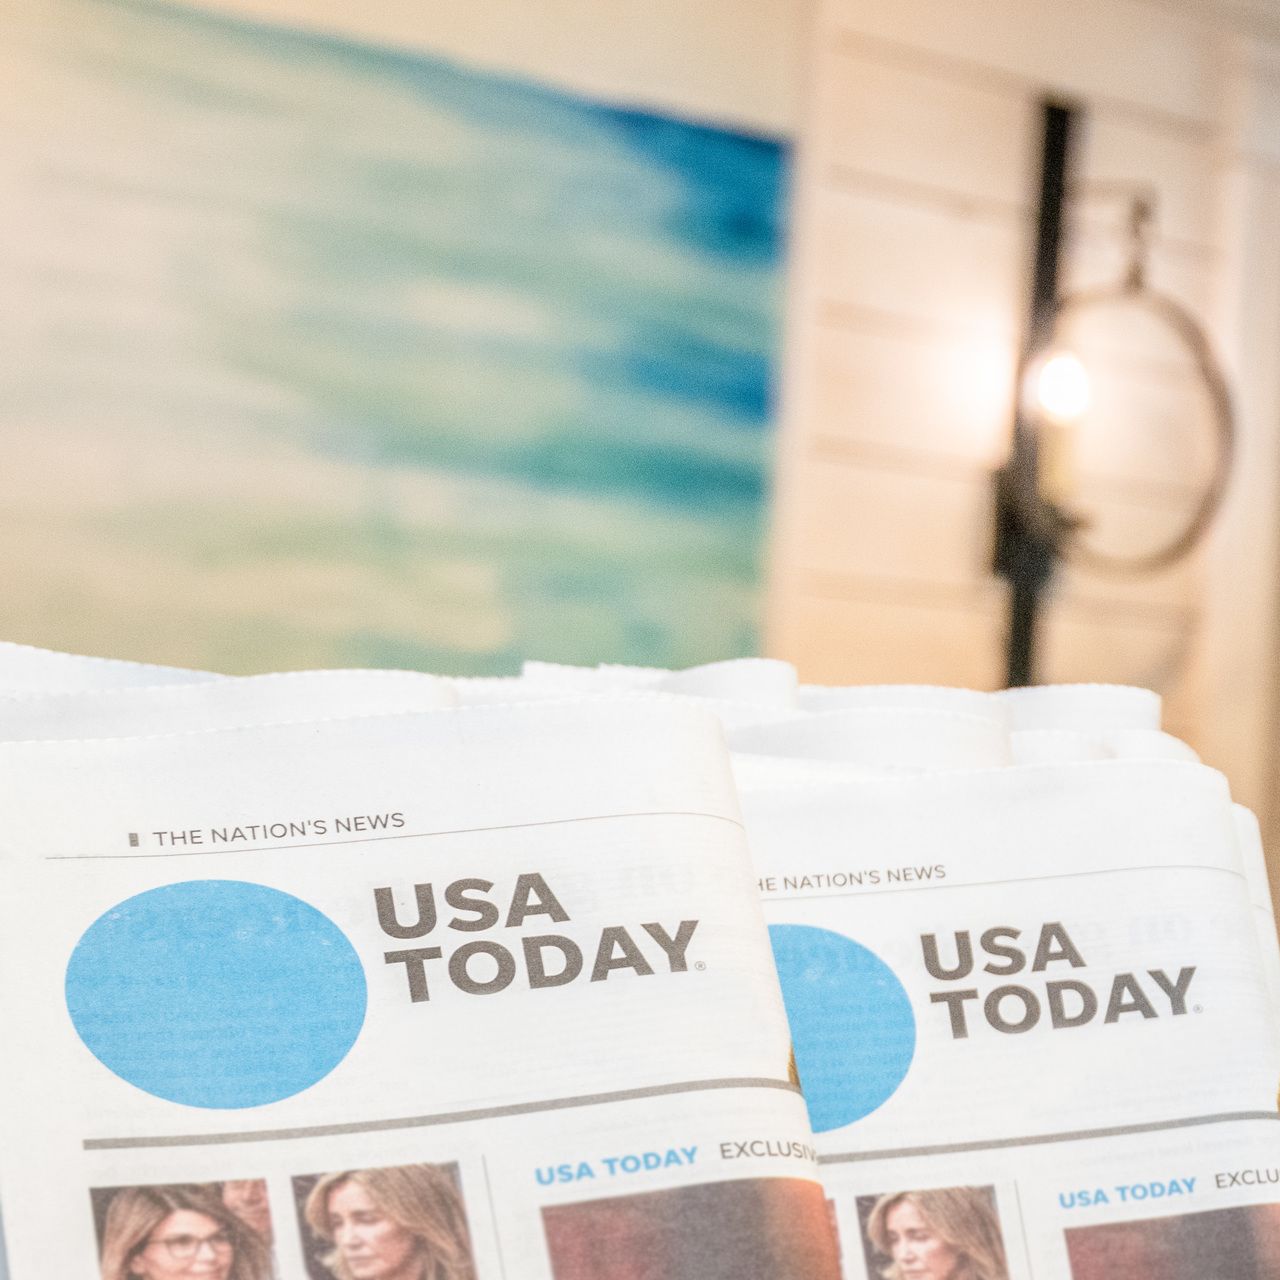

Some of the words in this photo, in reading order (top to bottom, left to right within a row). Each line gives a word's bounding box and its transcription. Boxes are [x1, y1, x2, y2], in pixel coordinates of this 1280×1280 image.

[153, 830, 203, 846] THE
[212, 820, 326, 843] NATION'S
[335, 813, 405, 833] NEWS
[783, 870, 880, 889] NATION'S
[887, 865, 946, 882] NEWS
[373, 872, 570, 940] USA
[384, 920, 699, 1004] TODAY
[920, 921, 1086, 981] USA
[930, 966, 1197, 1040] TODAY
[535, 1162, 595, 1186] USA
[602, 1146, 698, 1176] TODAY
[1059, 1189, 1110, 1209] USA
[1115, 1177, 1197, 1203] TODAY
